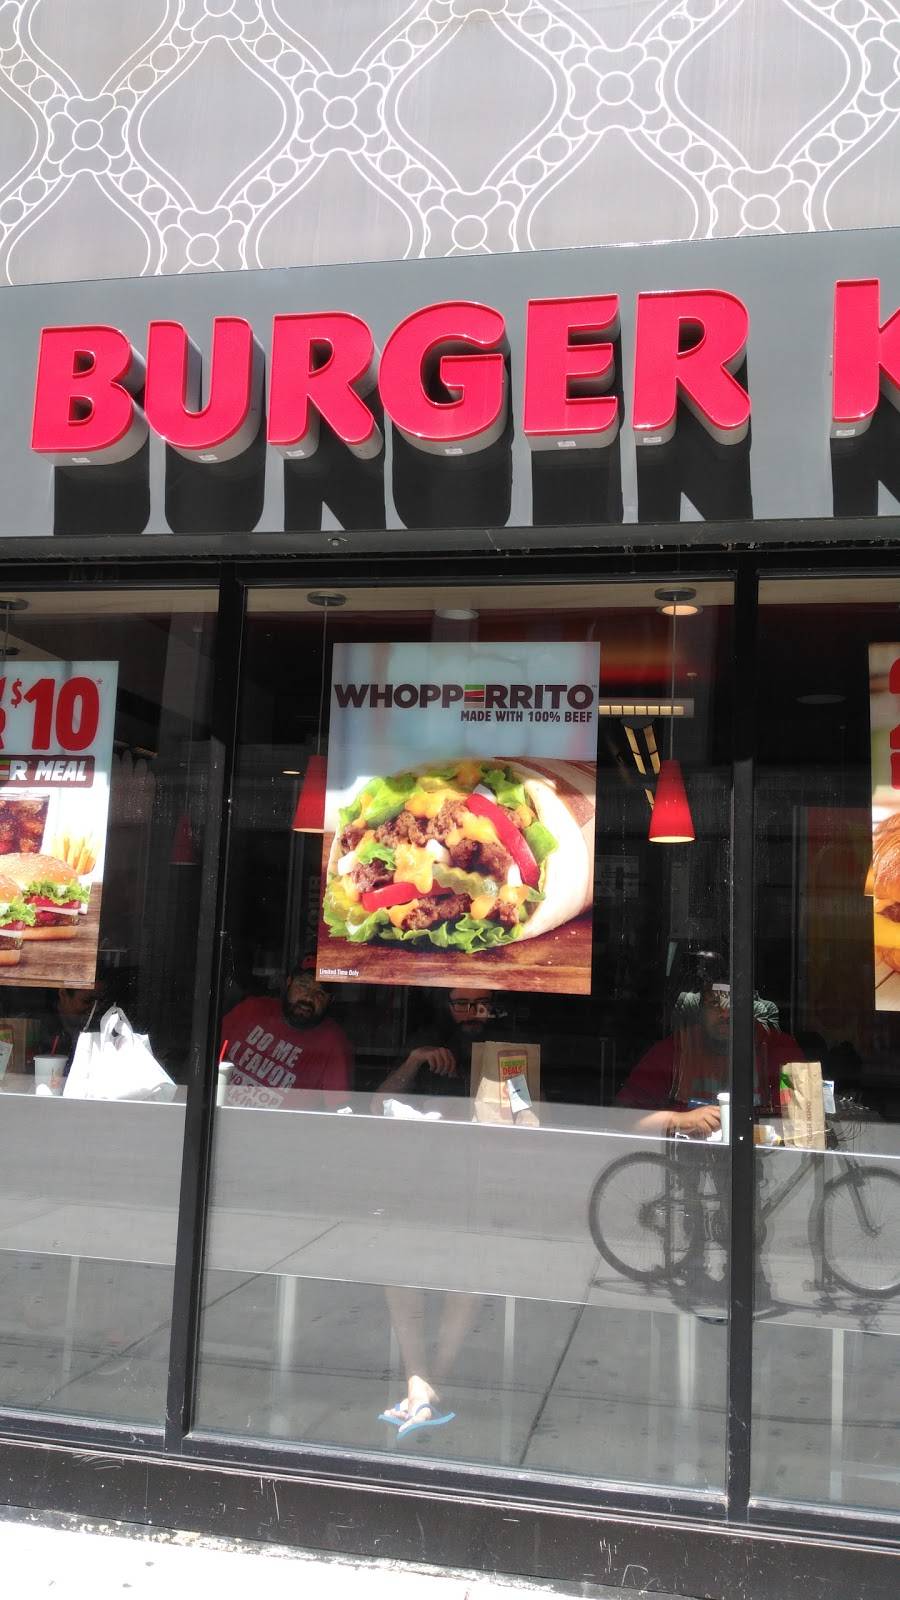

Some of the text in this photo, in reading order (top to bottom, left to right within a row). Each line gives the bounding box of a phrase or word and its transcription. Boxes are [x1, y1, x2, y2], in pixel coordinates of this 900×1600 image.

[32, 290, 752, 458] BURGER
[334, 683, 594, 710] WHOPPERRITO
[460, 710, 593, 723] MADE WITH 100% BEEF
[34, 760, 87, 782] MEAL
[320, 968, 337, 976] Limited
[348, 969, 360, 977] Only
[245, 1024, 303, 1068] DO ME
[238, 1047, 297, 1093] FAVOR
